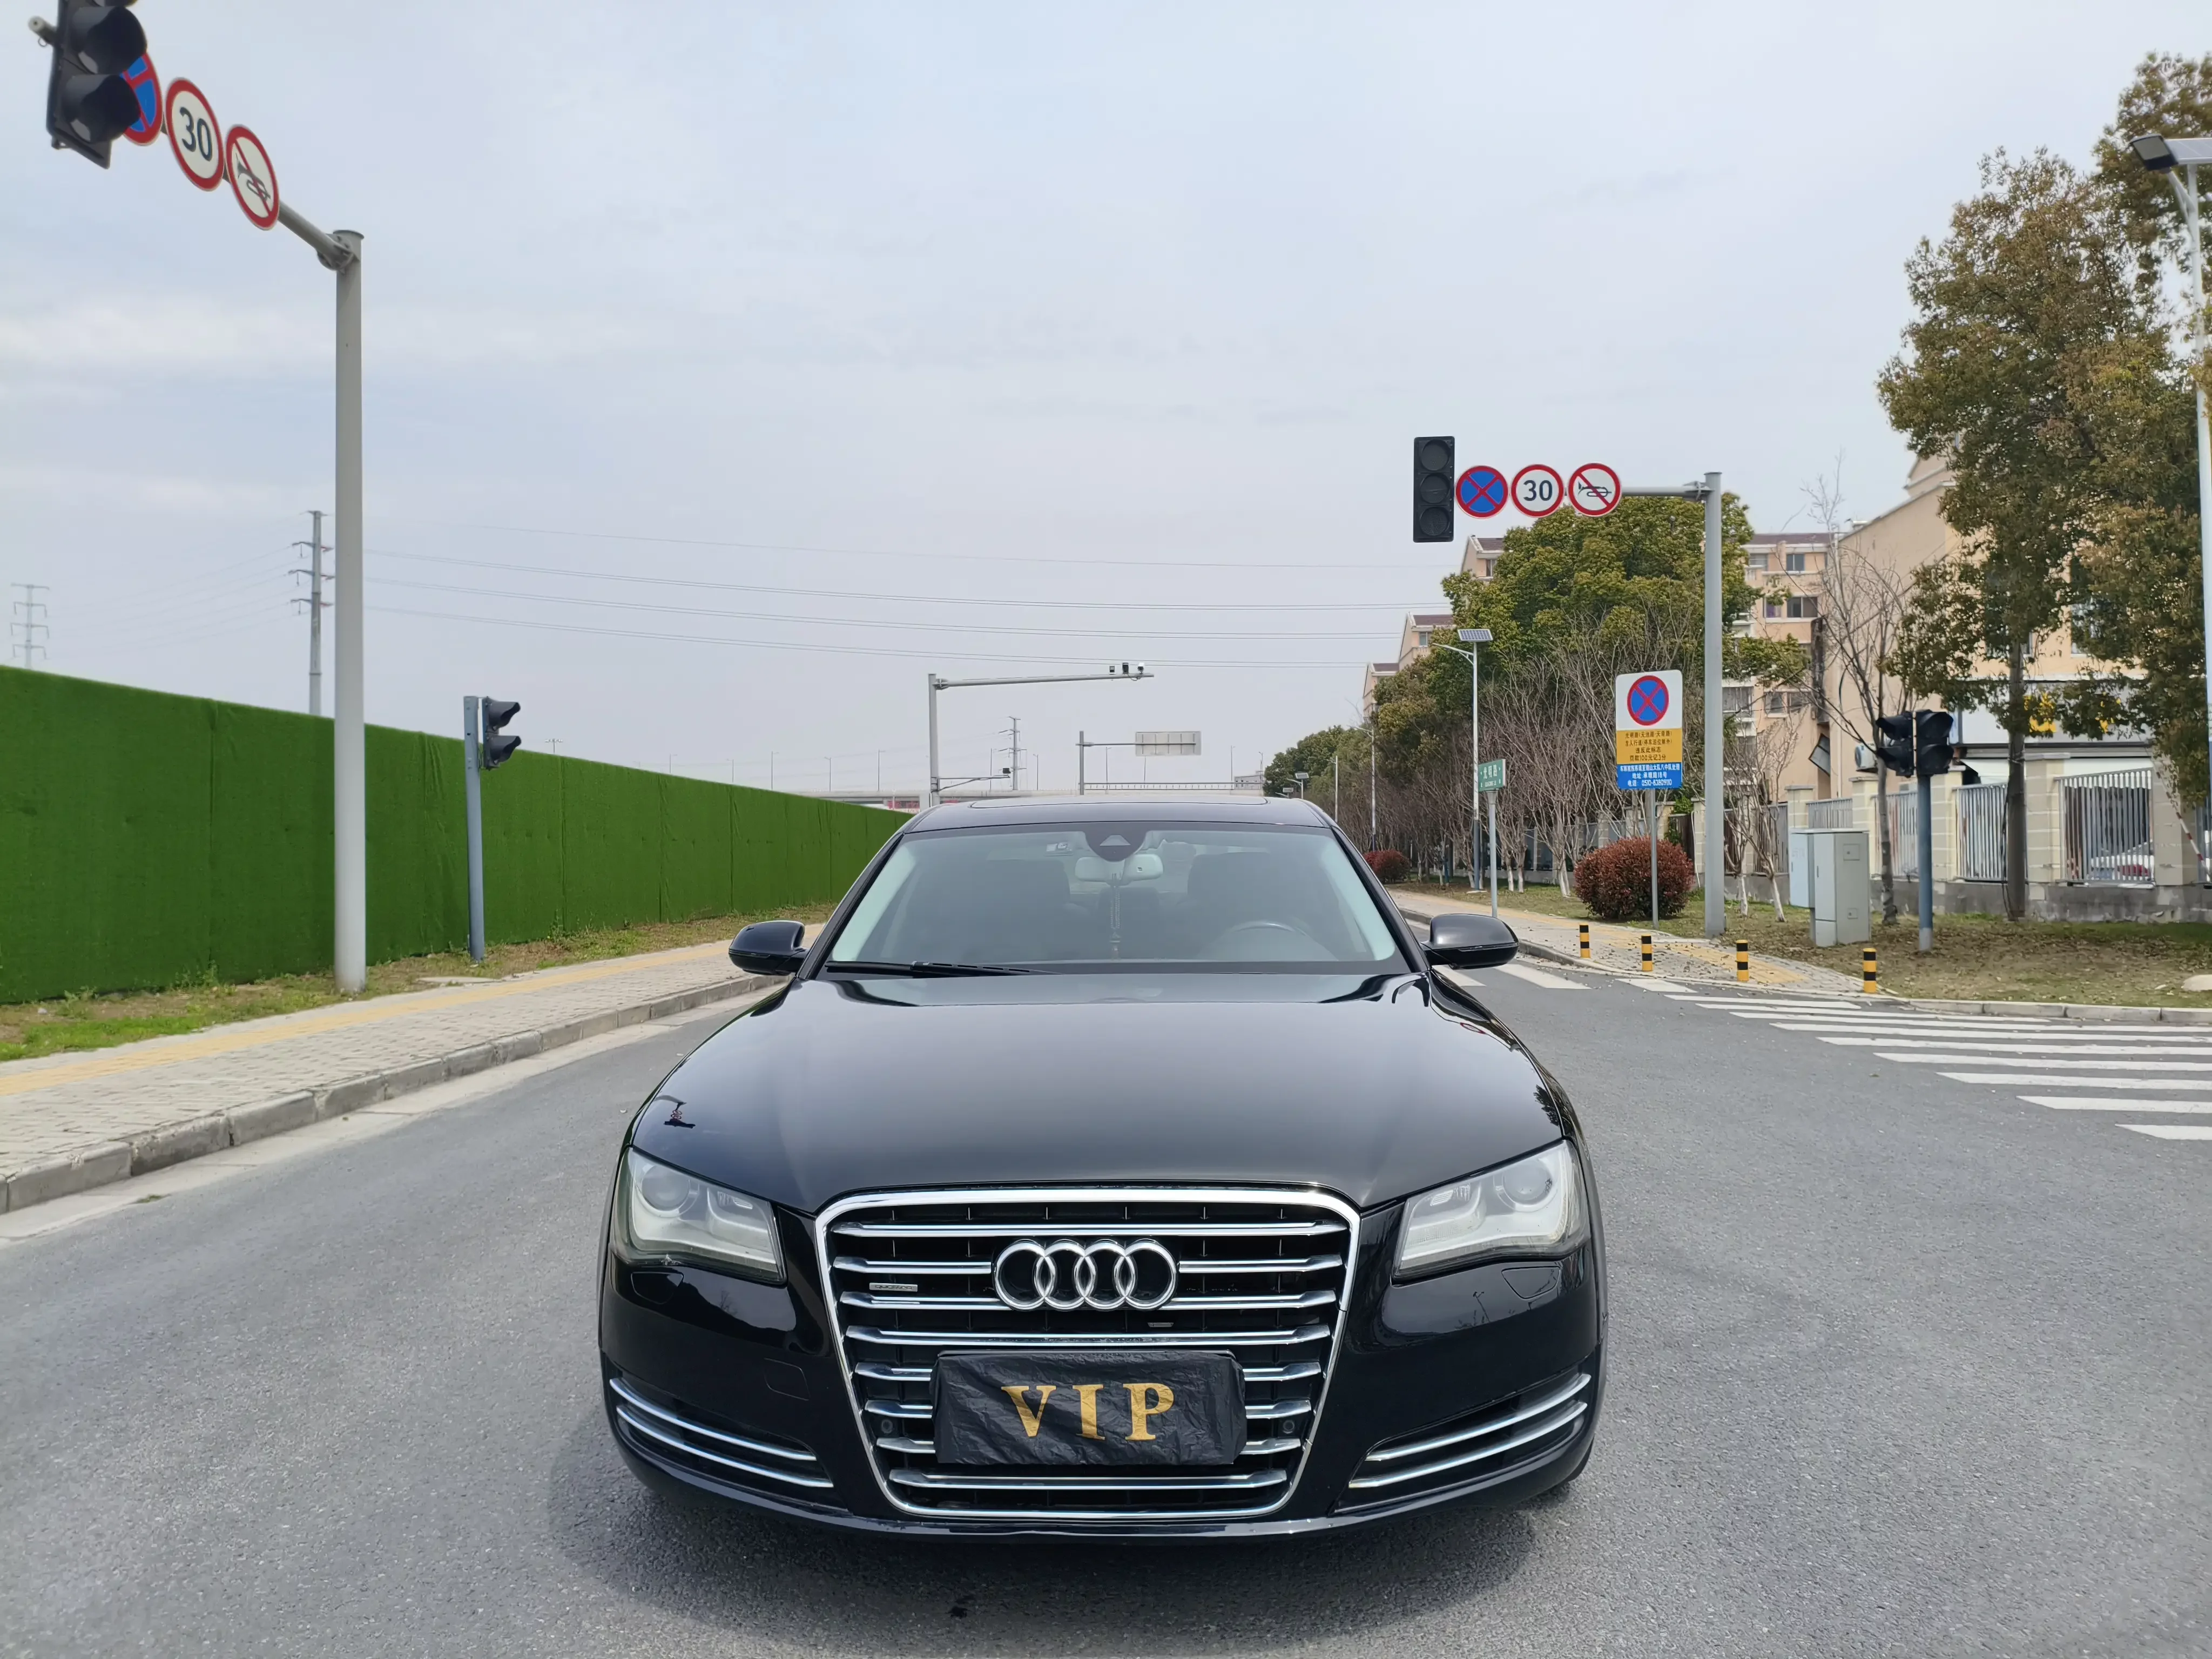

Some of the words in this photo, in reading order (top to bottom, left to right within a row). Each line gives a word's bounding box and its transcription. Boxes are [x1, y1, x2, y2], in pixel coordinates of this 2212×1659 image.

[179, 107, 213, 161] 30
[1523, 480, 1553, 501] 30
[1001, 1383, 1174, 1441] VIP
